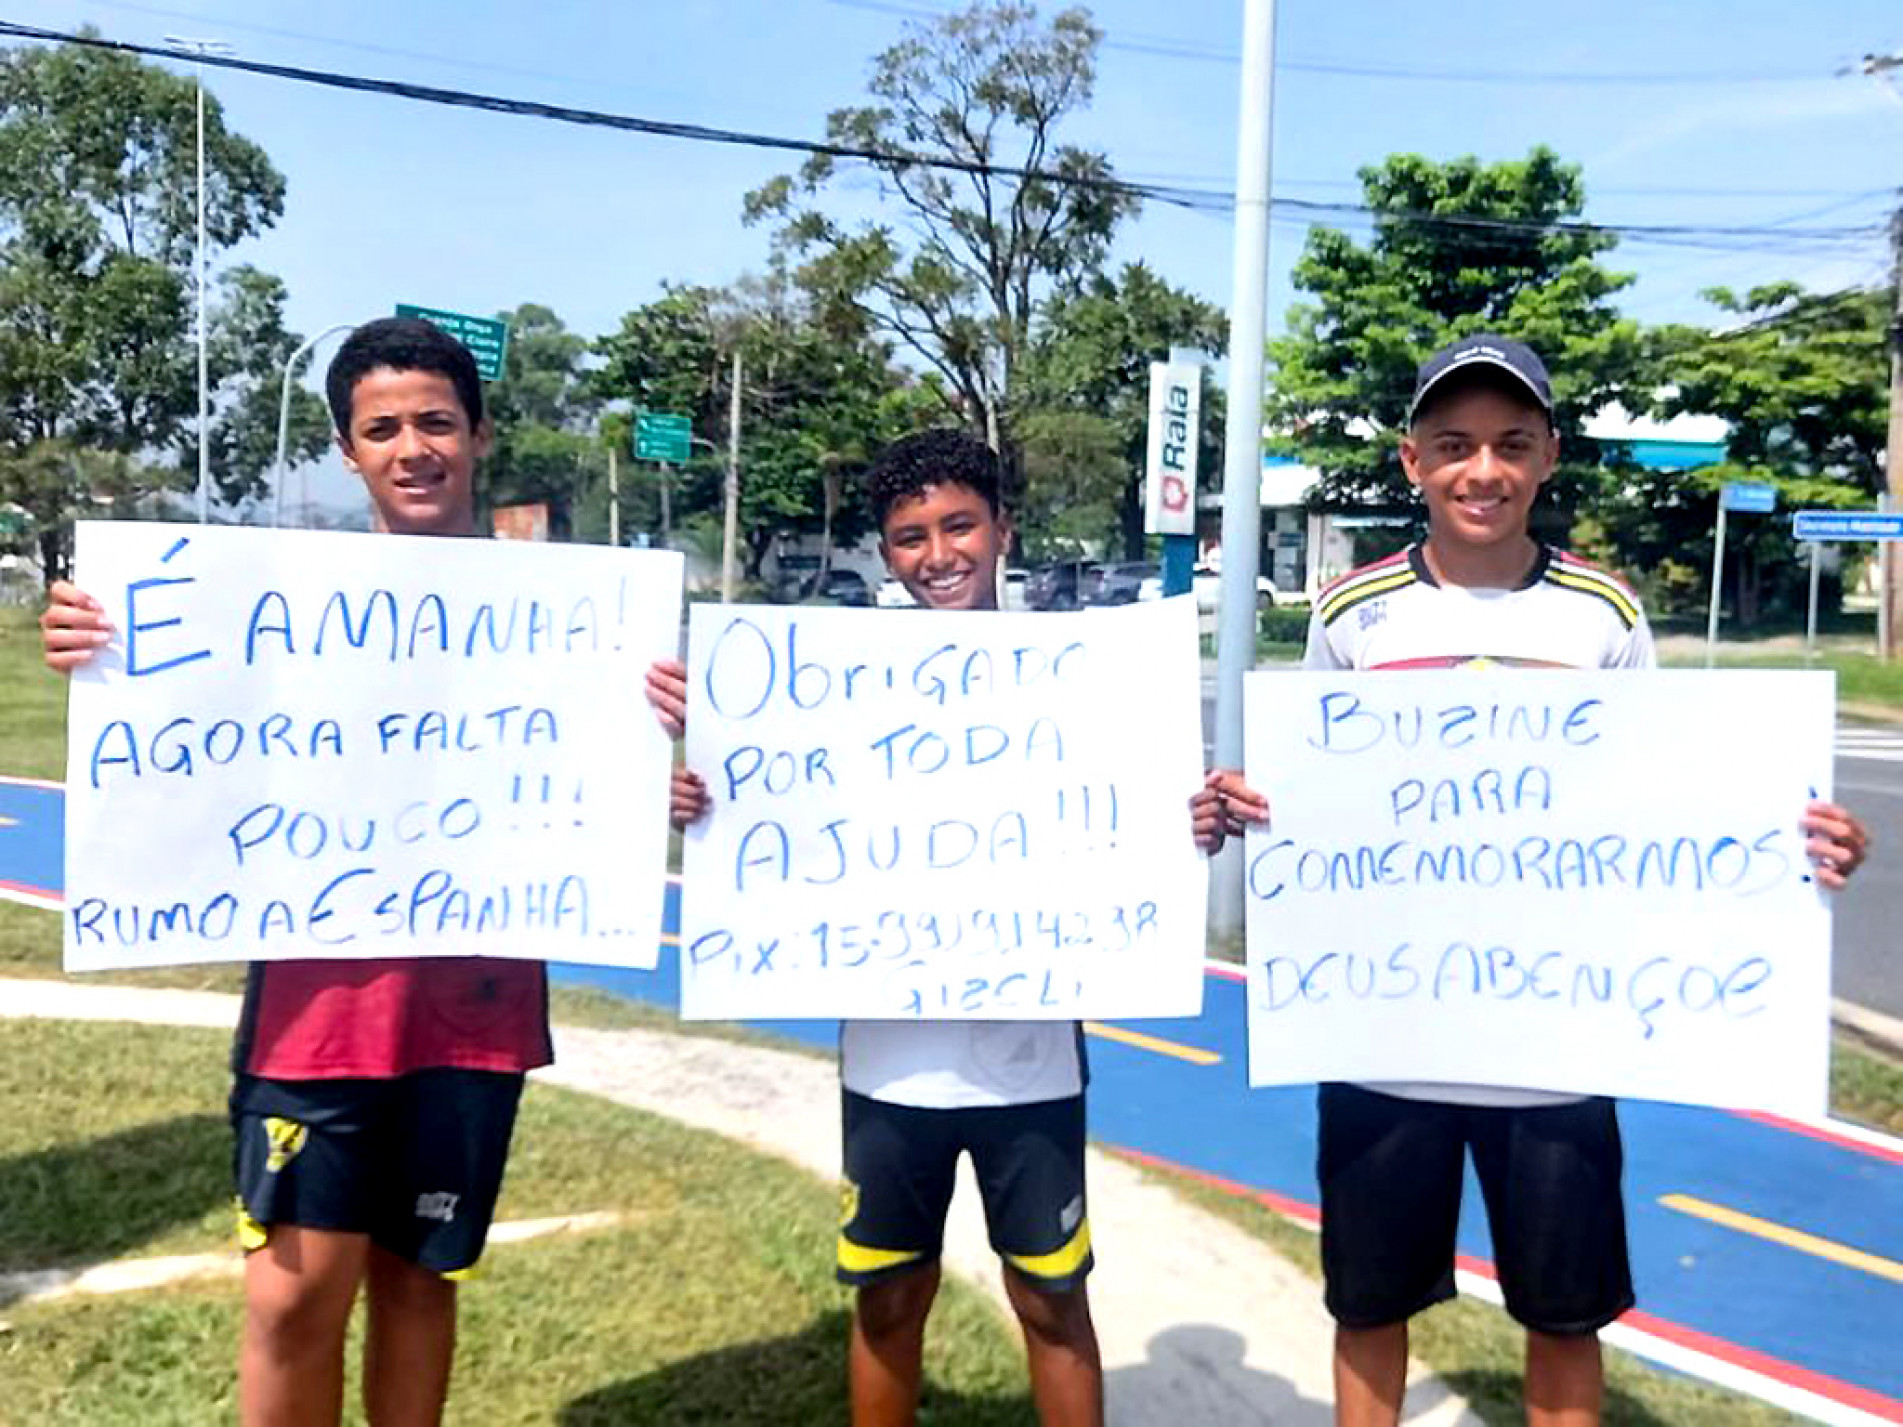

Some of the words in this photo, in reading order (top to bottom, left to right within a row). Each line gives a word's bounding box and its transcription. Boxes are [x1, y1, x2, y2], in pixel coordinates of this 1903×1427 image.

[125, 537, 212, 678] É
[90, 708, 343, 789] AGORA
[376, 704, 559, 756] FALTA
[722, 745, 836, 802] POR
[870, 716, 1066, 781] TODA
[1306, 690, 1604, 754] BUZINE
[1390, 763, 1553, 827] PARA
[70, 892, 240, 948] RUMO
[258, 900, 296, 942] A
